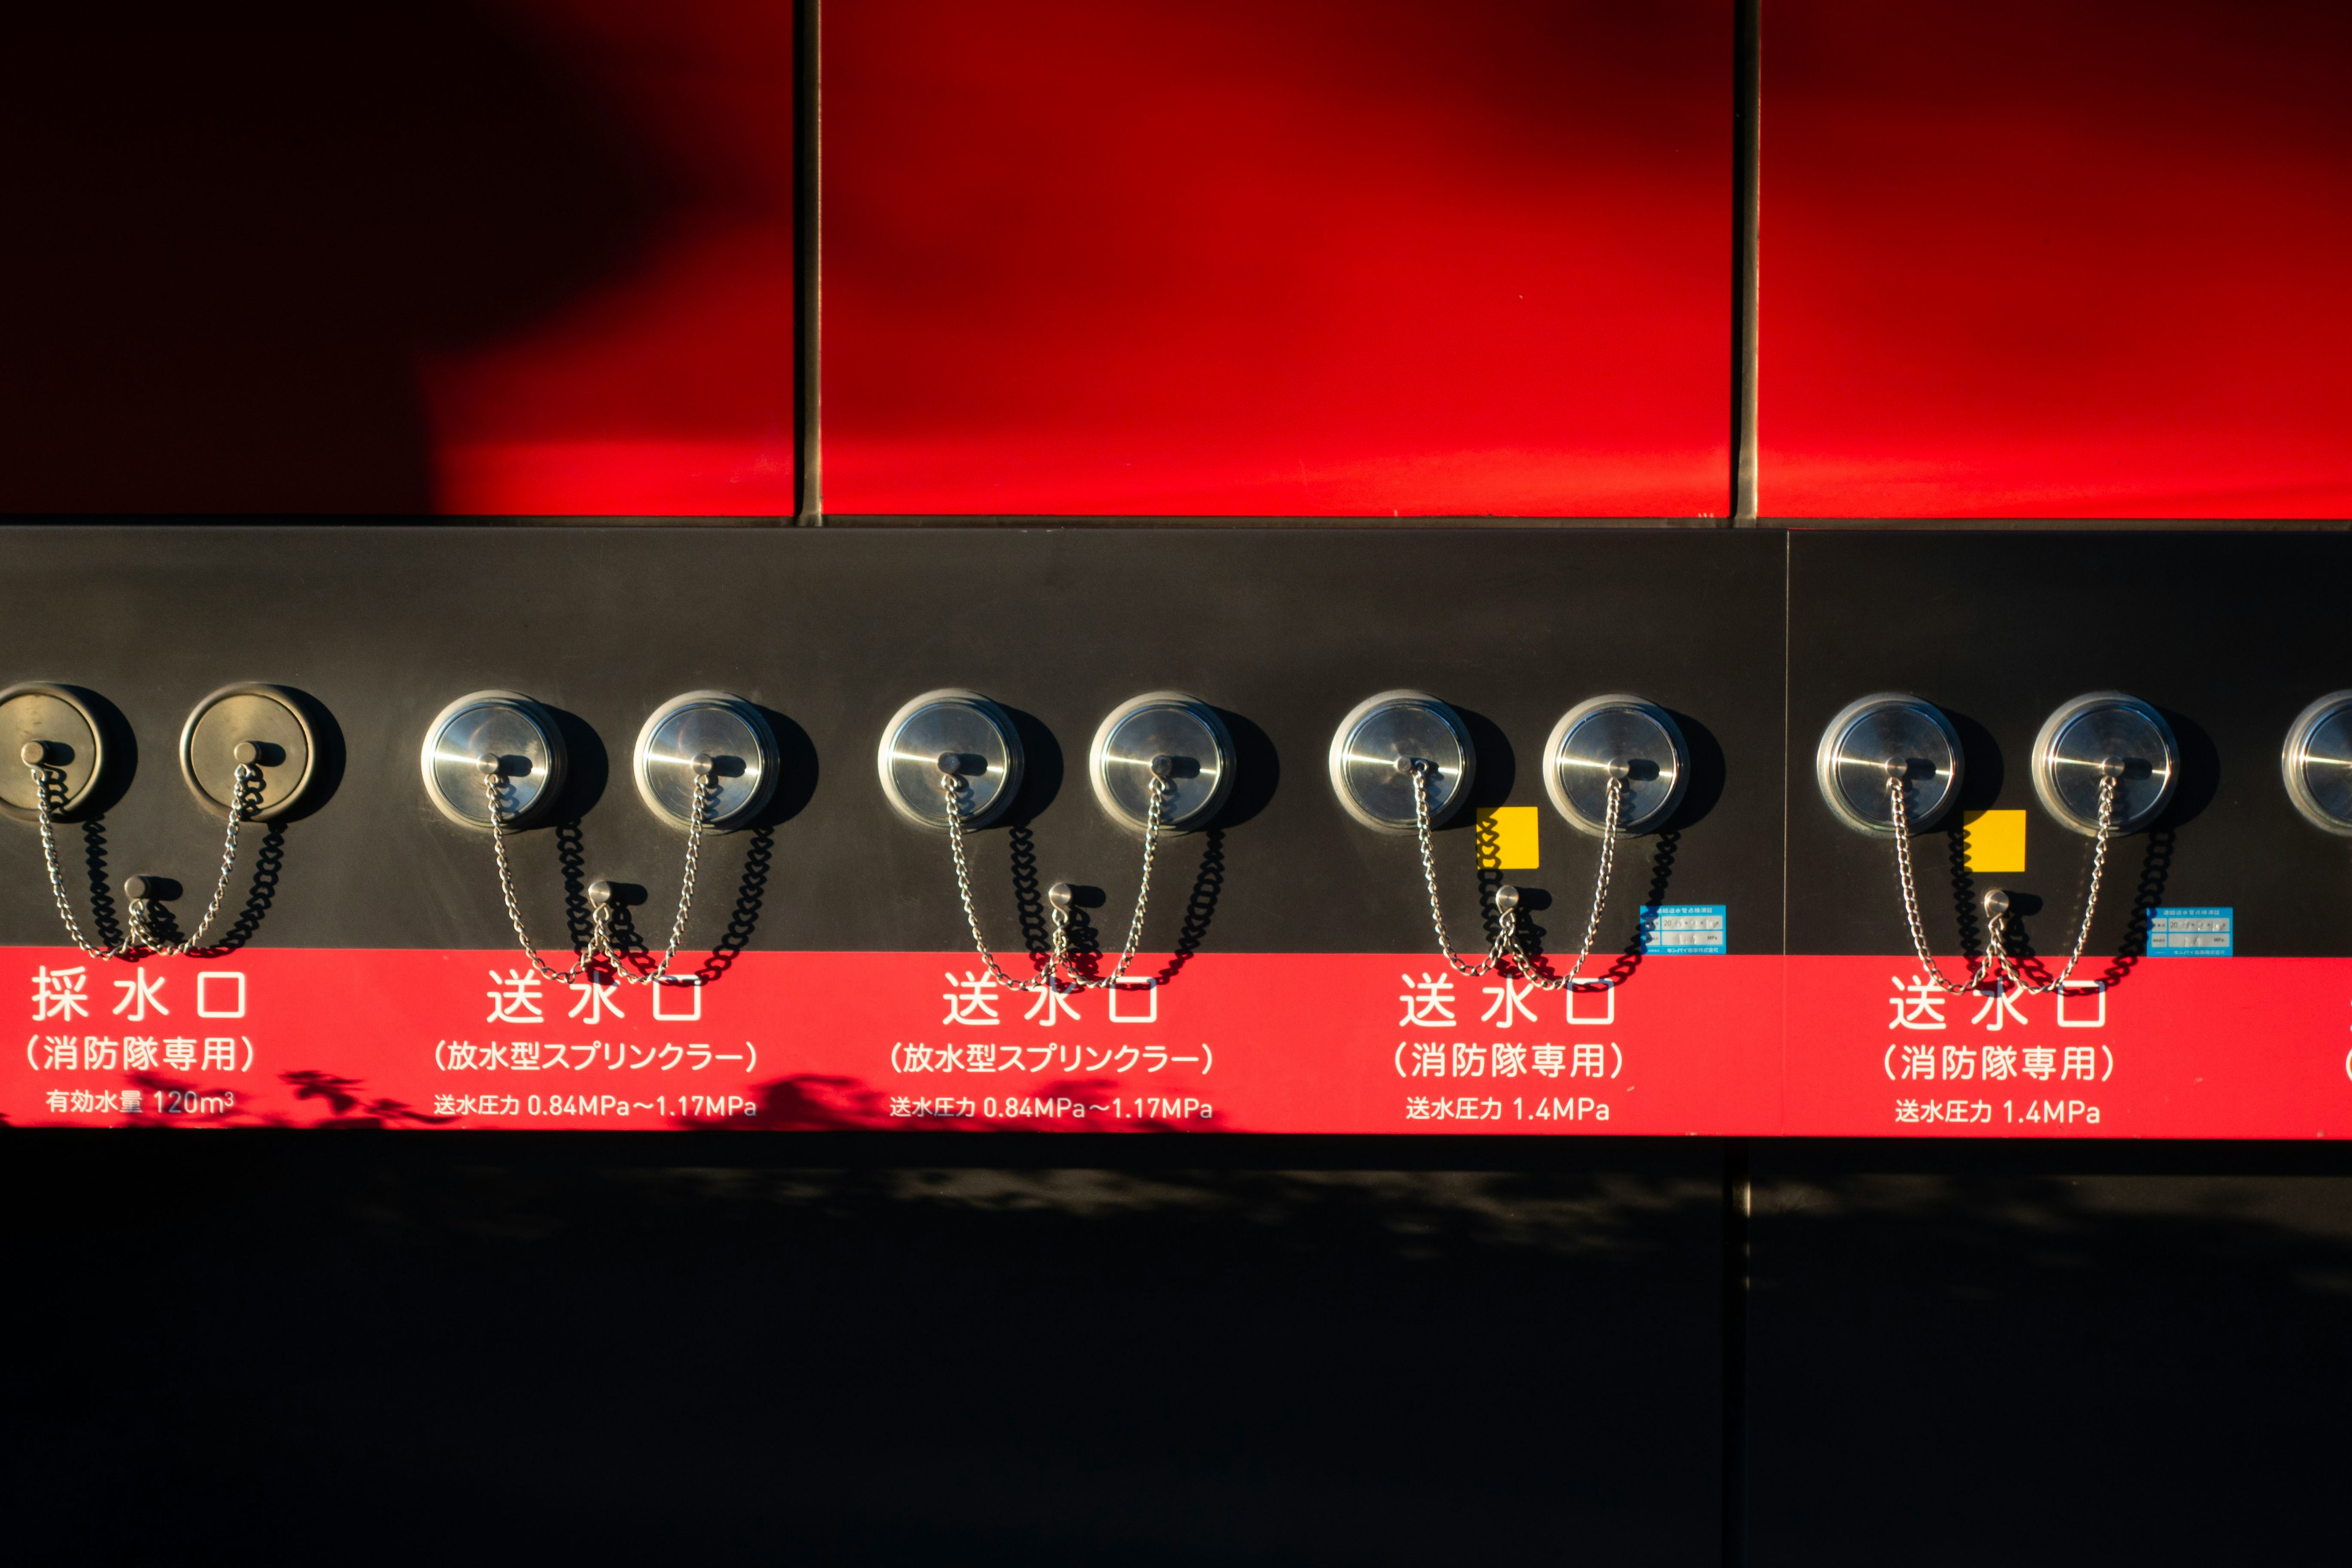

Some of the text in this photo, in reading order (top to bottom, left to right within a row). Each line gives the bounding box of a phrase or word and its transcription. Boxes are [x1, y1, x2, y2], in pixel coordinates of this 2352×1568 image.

[32, 965, 246, 1022] 採水口
[486, 970, 701, 1025] 送水口
[943, 971, 1157, 1027] 送水口
[1399, 973, 1615, 1028] 送水口
[1889, 974, 2106, 1031] 送水口
[27, 1035, 254, 1072] （消防隊専用）
[435, 1040, 756, 1072] （放水型スプリンクラー）
[891, 1042, 1212, 1074] （放水型スプリンクラー）
[1395, 1041, 1622, 1079] （消防隊専用）
[1885, 1044, 2113, 1082] （消防隊専用）
[46, 1089, 142, 1113] 有効水量
[434, 1094, 519, 1115] 送水圧力
[890, 1096, 975, 1117] 送水圧力
[1406, 1096, 1609, 1120] 送水圧力 1.4MPa
[1896, 1099, 2100, 1123] 送水圧力 1.4MPa
